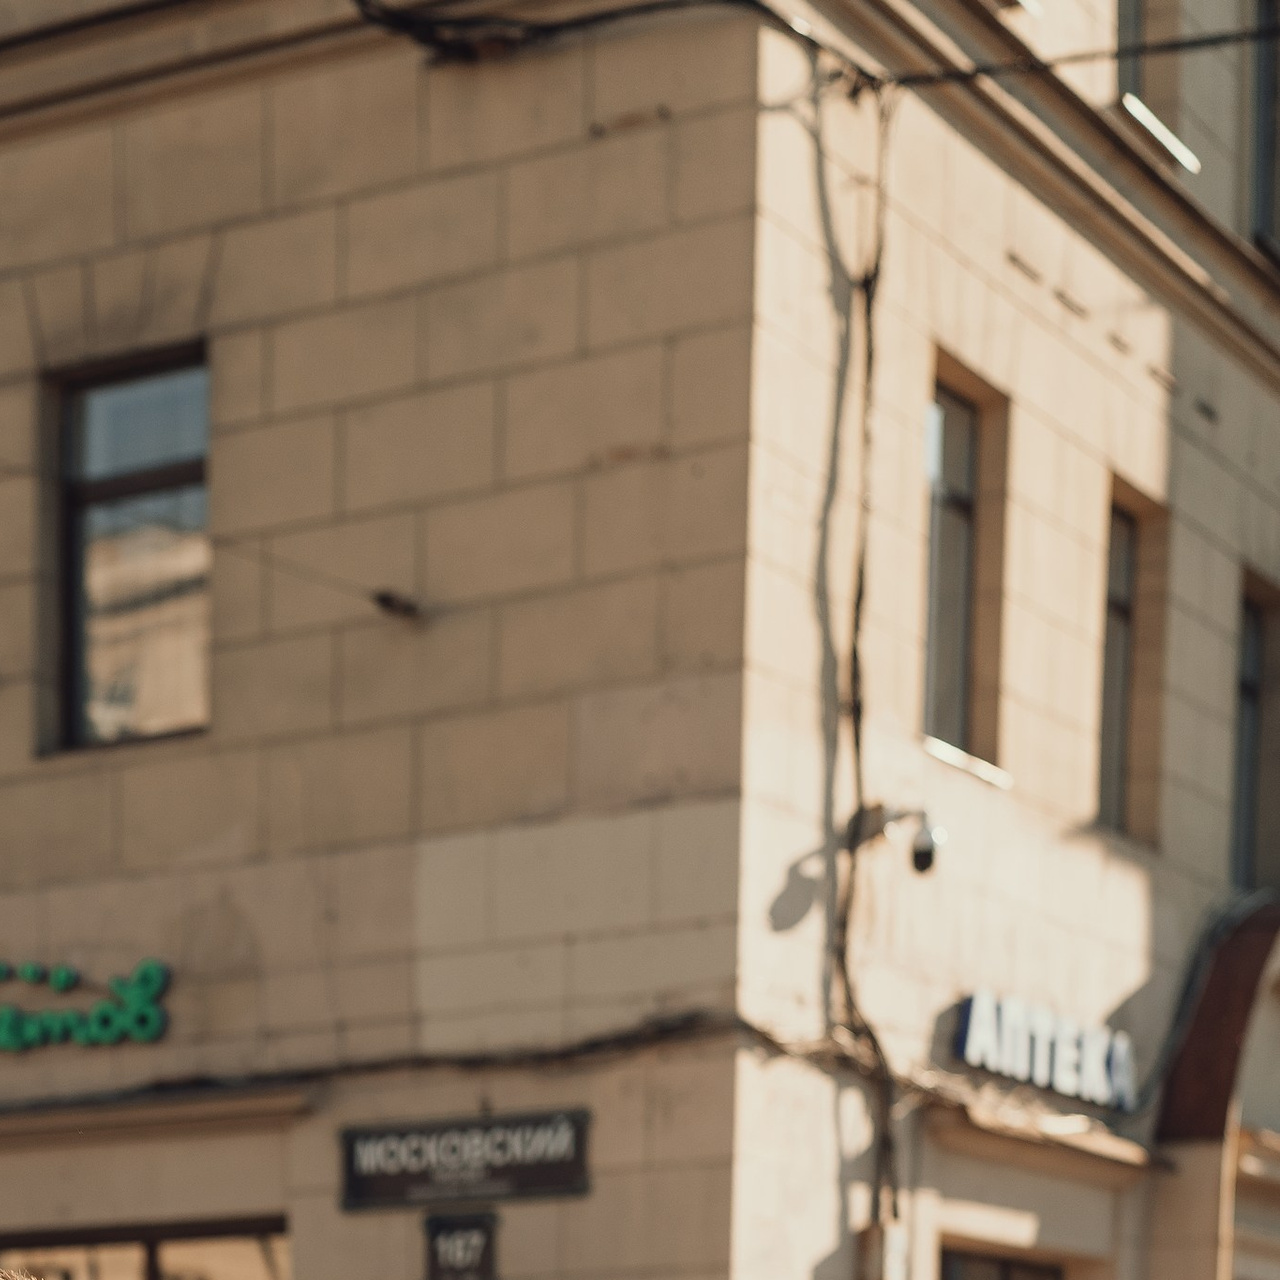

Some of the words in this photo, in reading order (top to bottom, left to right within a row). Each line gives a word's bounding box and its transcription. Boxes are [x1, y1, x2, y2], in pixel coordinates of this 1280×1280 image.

[963, 987, 1139, 1115] АПТЕКА
[353, 1113, 577, 1175] МОСКОВСКИЙ
[434, 1230, 488, 1270] 167
